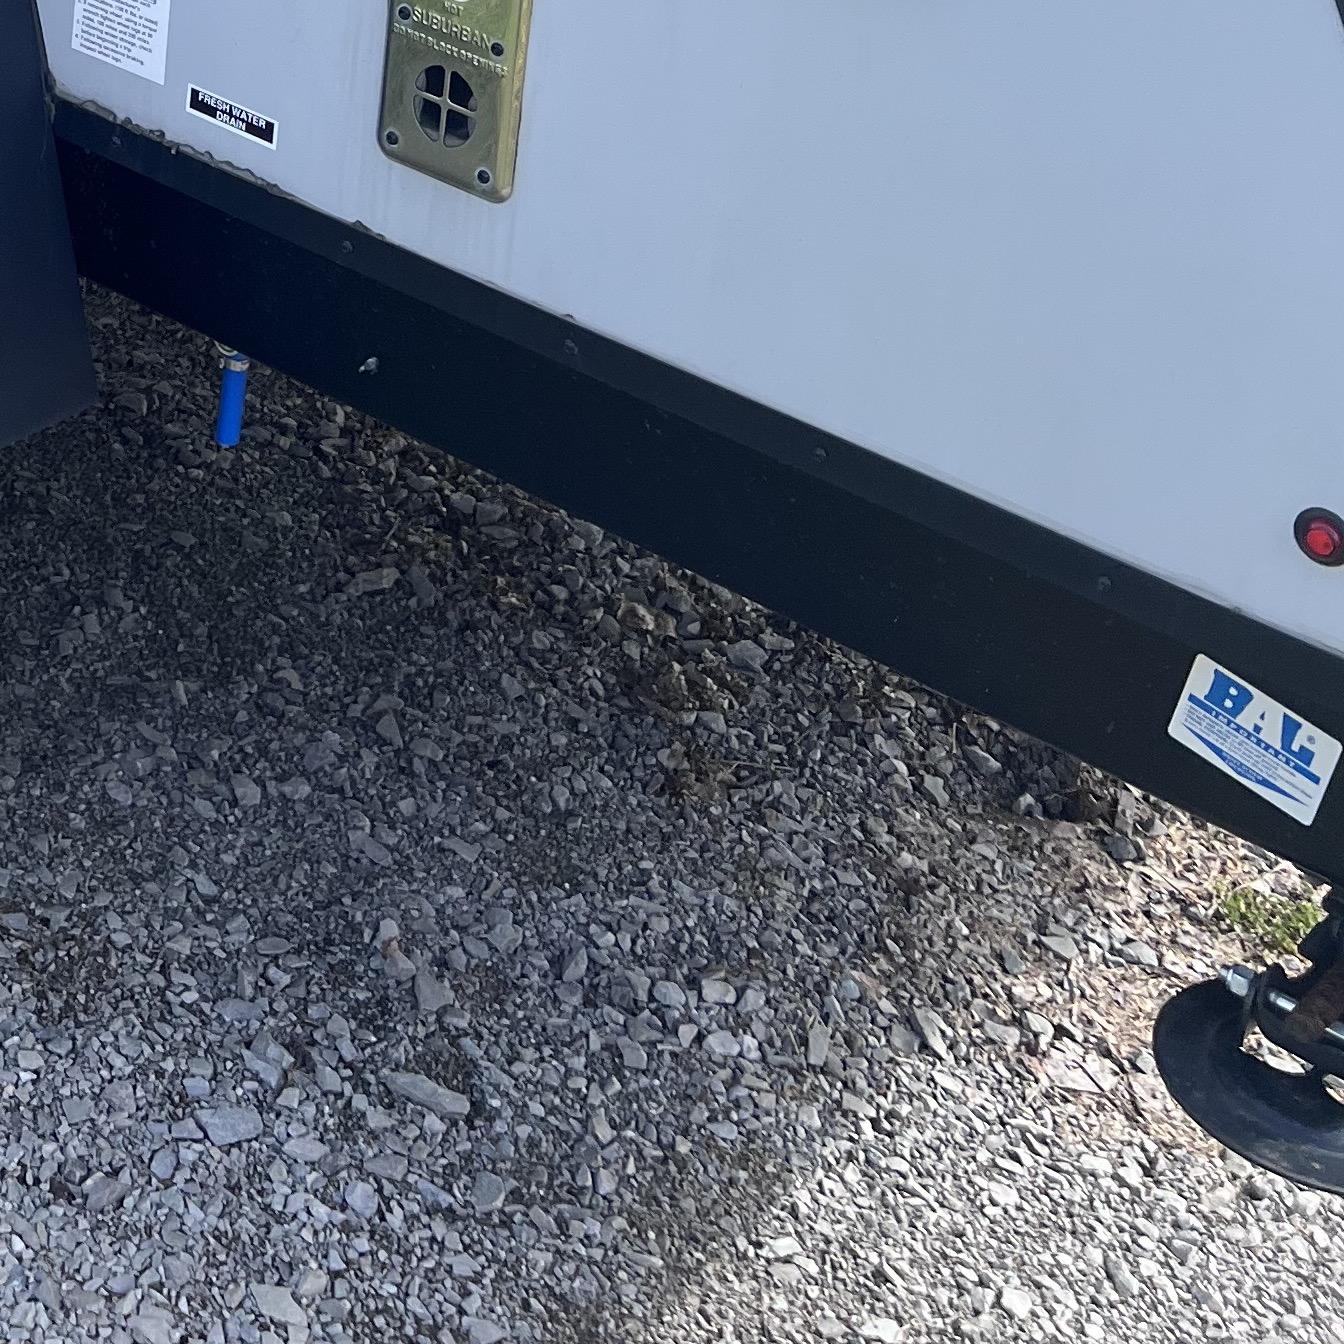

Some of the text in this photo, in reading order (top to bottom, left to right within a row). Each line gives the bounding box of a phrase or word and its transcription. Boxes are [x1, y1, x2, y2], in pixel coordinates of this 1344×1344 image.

[413, 6, 490, 50] SUBURBAN
[198, 91, 266, 129] FRESH WATER
[216, 109, 245, 131] DRAIN
[1210, 709, 1296, 768] IMPORTANT
